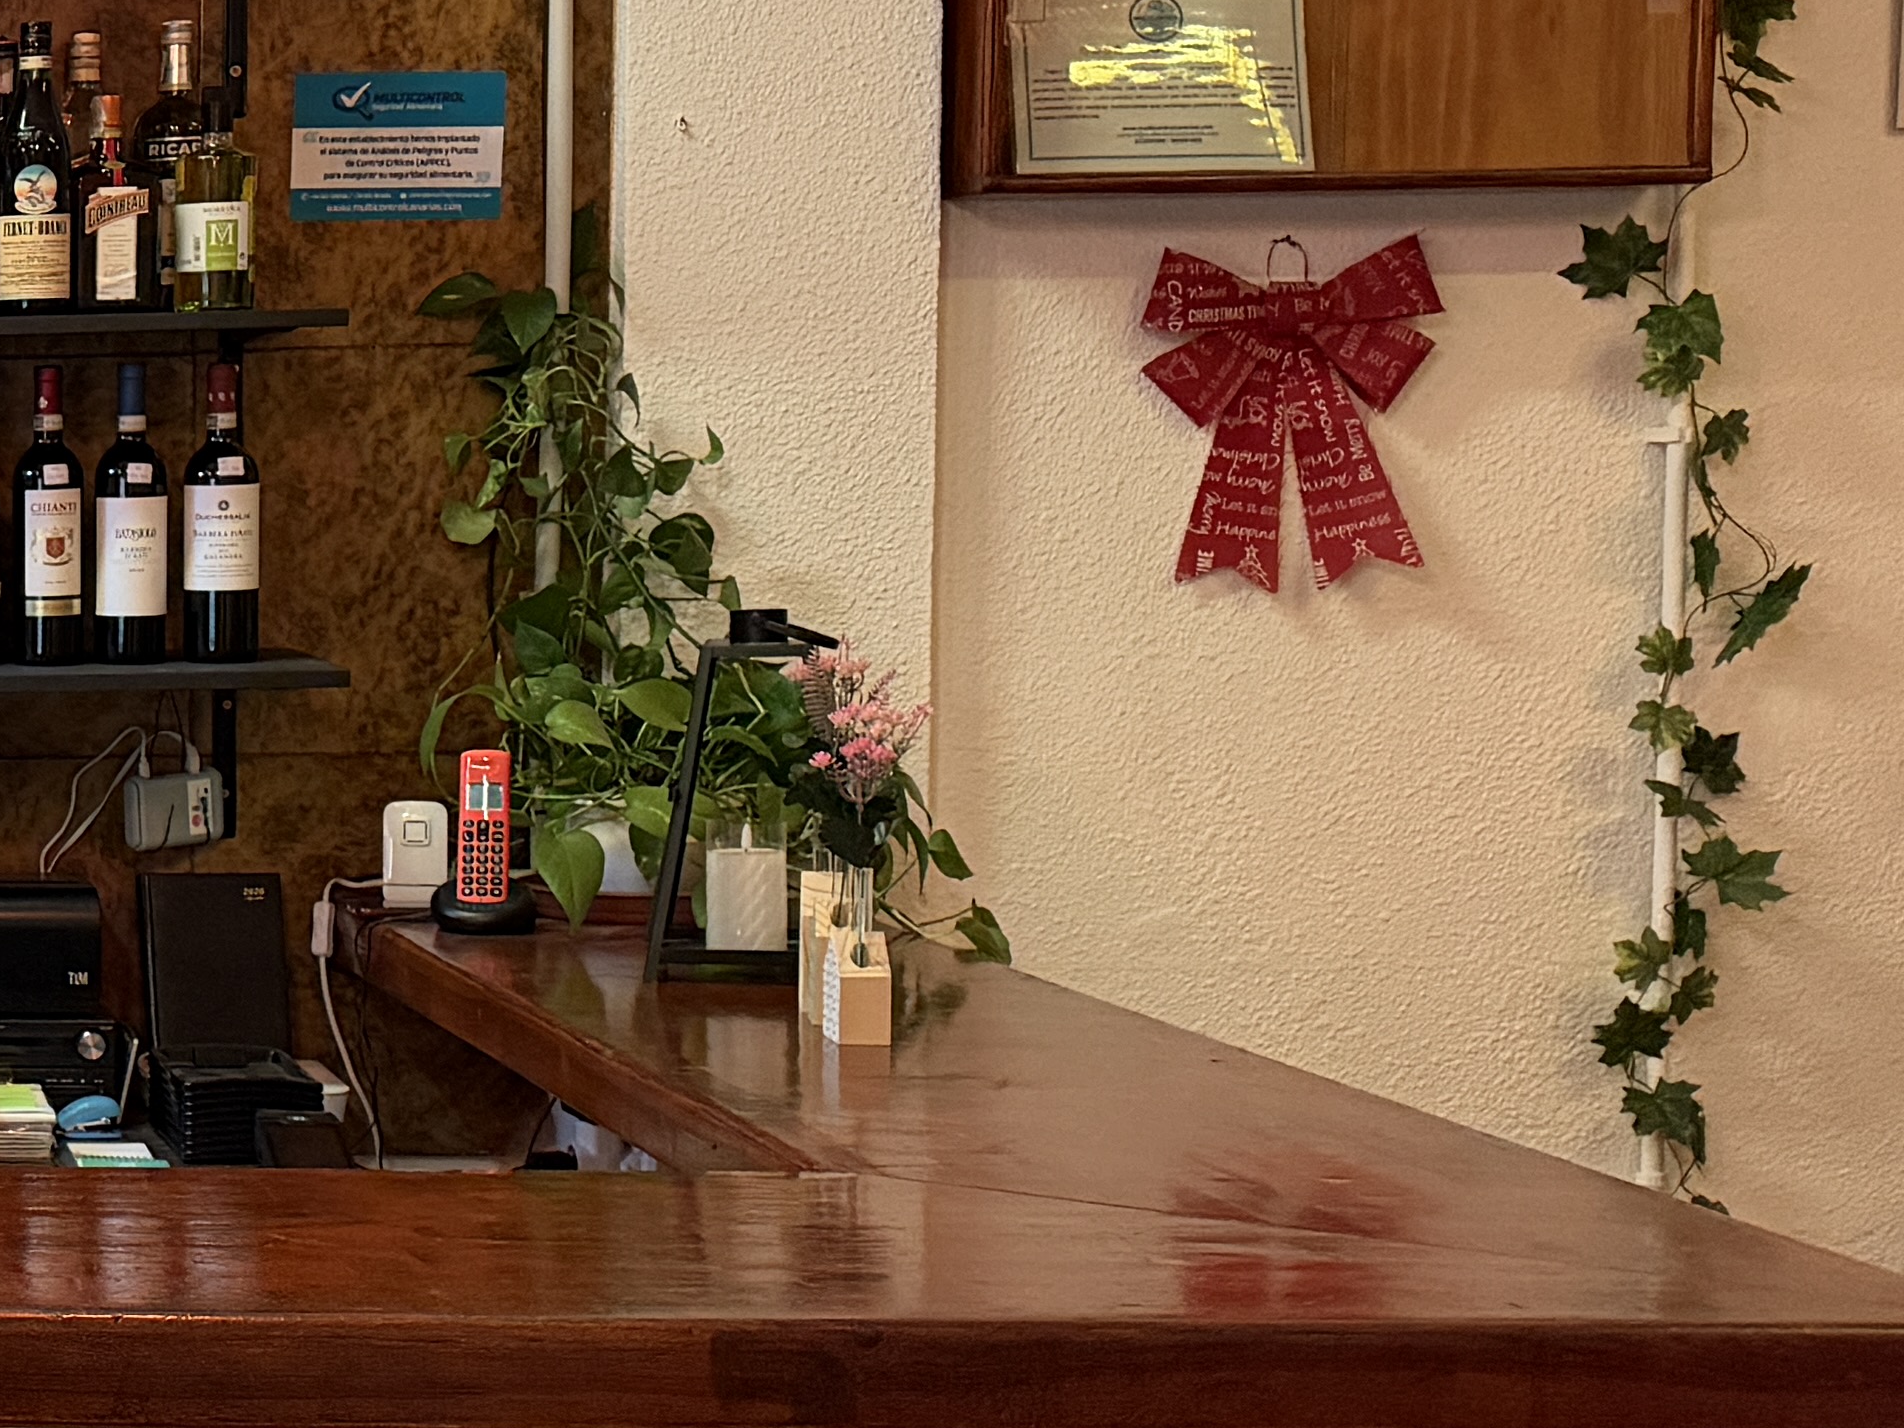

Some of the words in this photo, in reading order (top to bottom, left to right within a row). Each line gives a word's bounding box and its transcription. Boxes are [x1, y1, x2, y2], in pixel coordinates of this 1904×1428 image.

[372, 92, 465, 104] MULTICONTROL
[88, 193, 149, 227] COINTREAU
[1188, 306, 1245, 323] CHRISTMAS
[1314, 399, 1337, 442] snow
[30, 502, 77, 513] CHIANTI
[1314, 512, 1392, 543] Happiness
